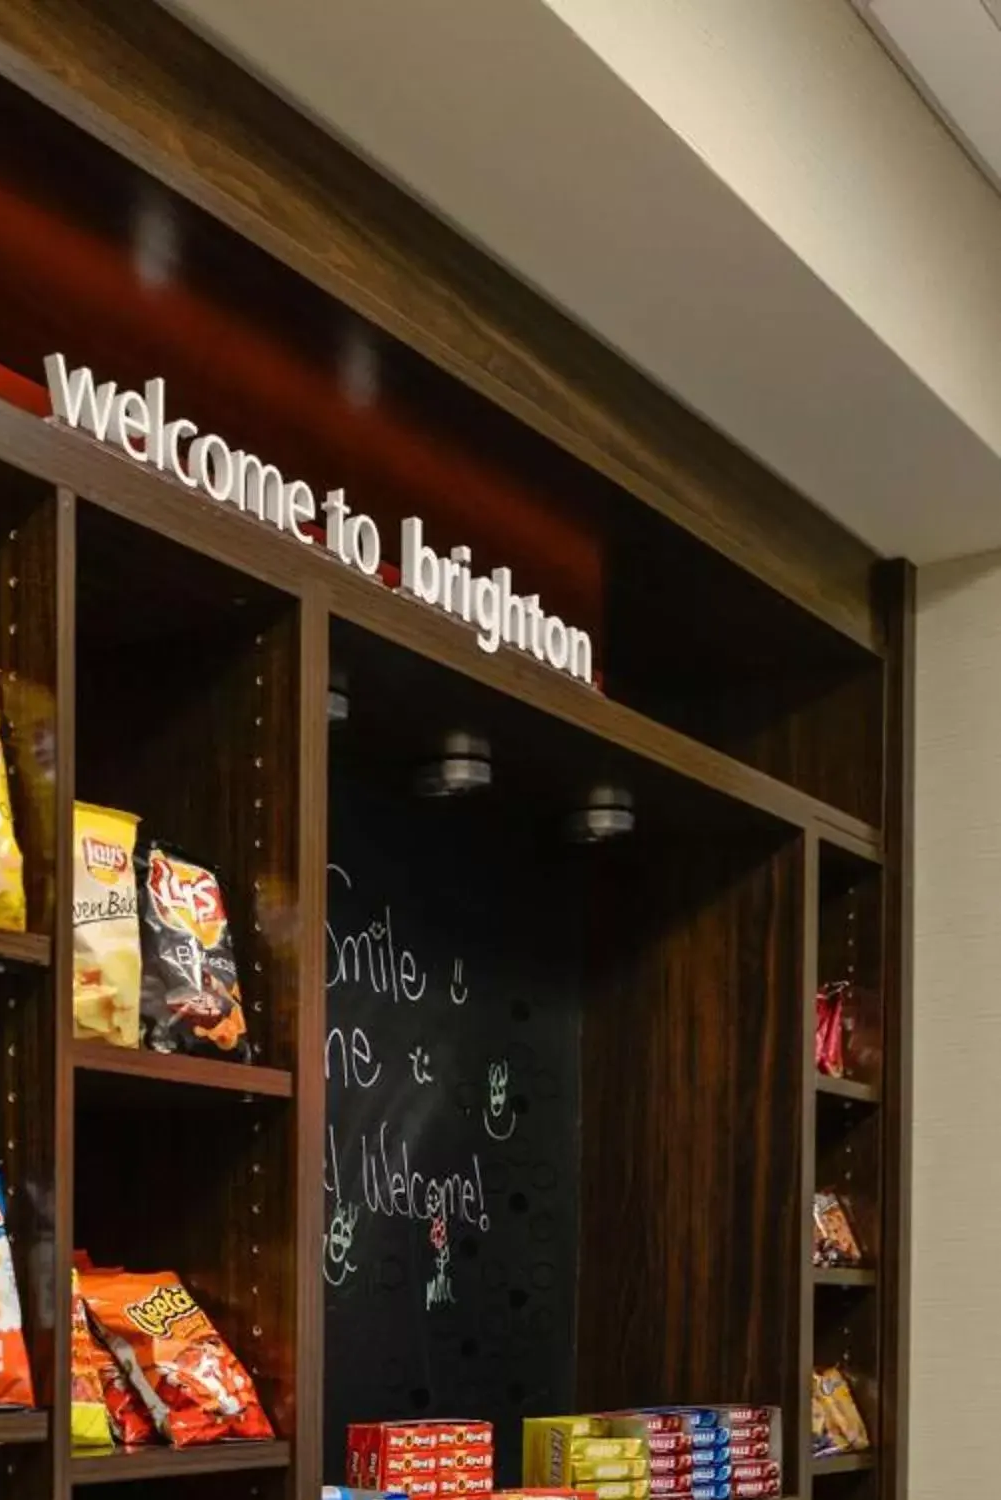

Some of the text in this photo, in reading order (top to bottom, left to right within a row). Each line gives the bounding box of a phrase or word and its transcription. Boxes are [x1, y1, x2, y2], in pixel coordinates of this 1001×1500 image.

[43, 352, 594, 684] welcome to brighton
[74, 897, 103, 919] ven
